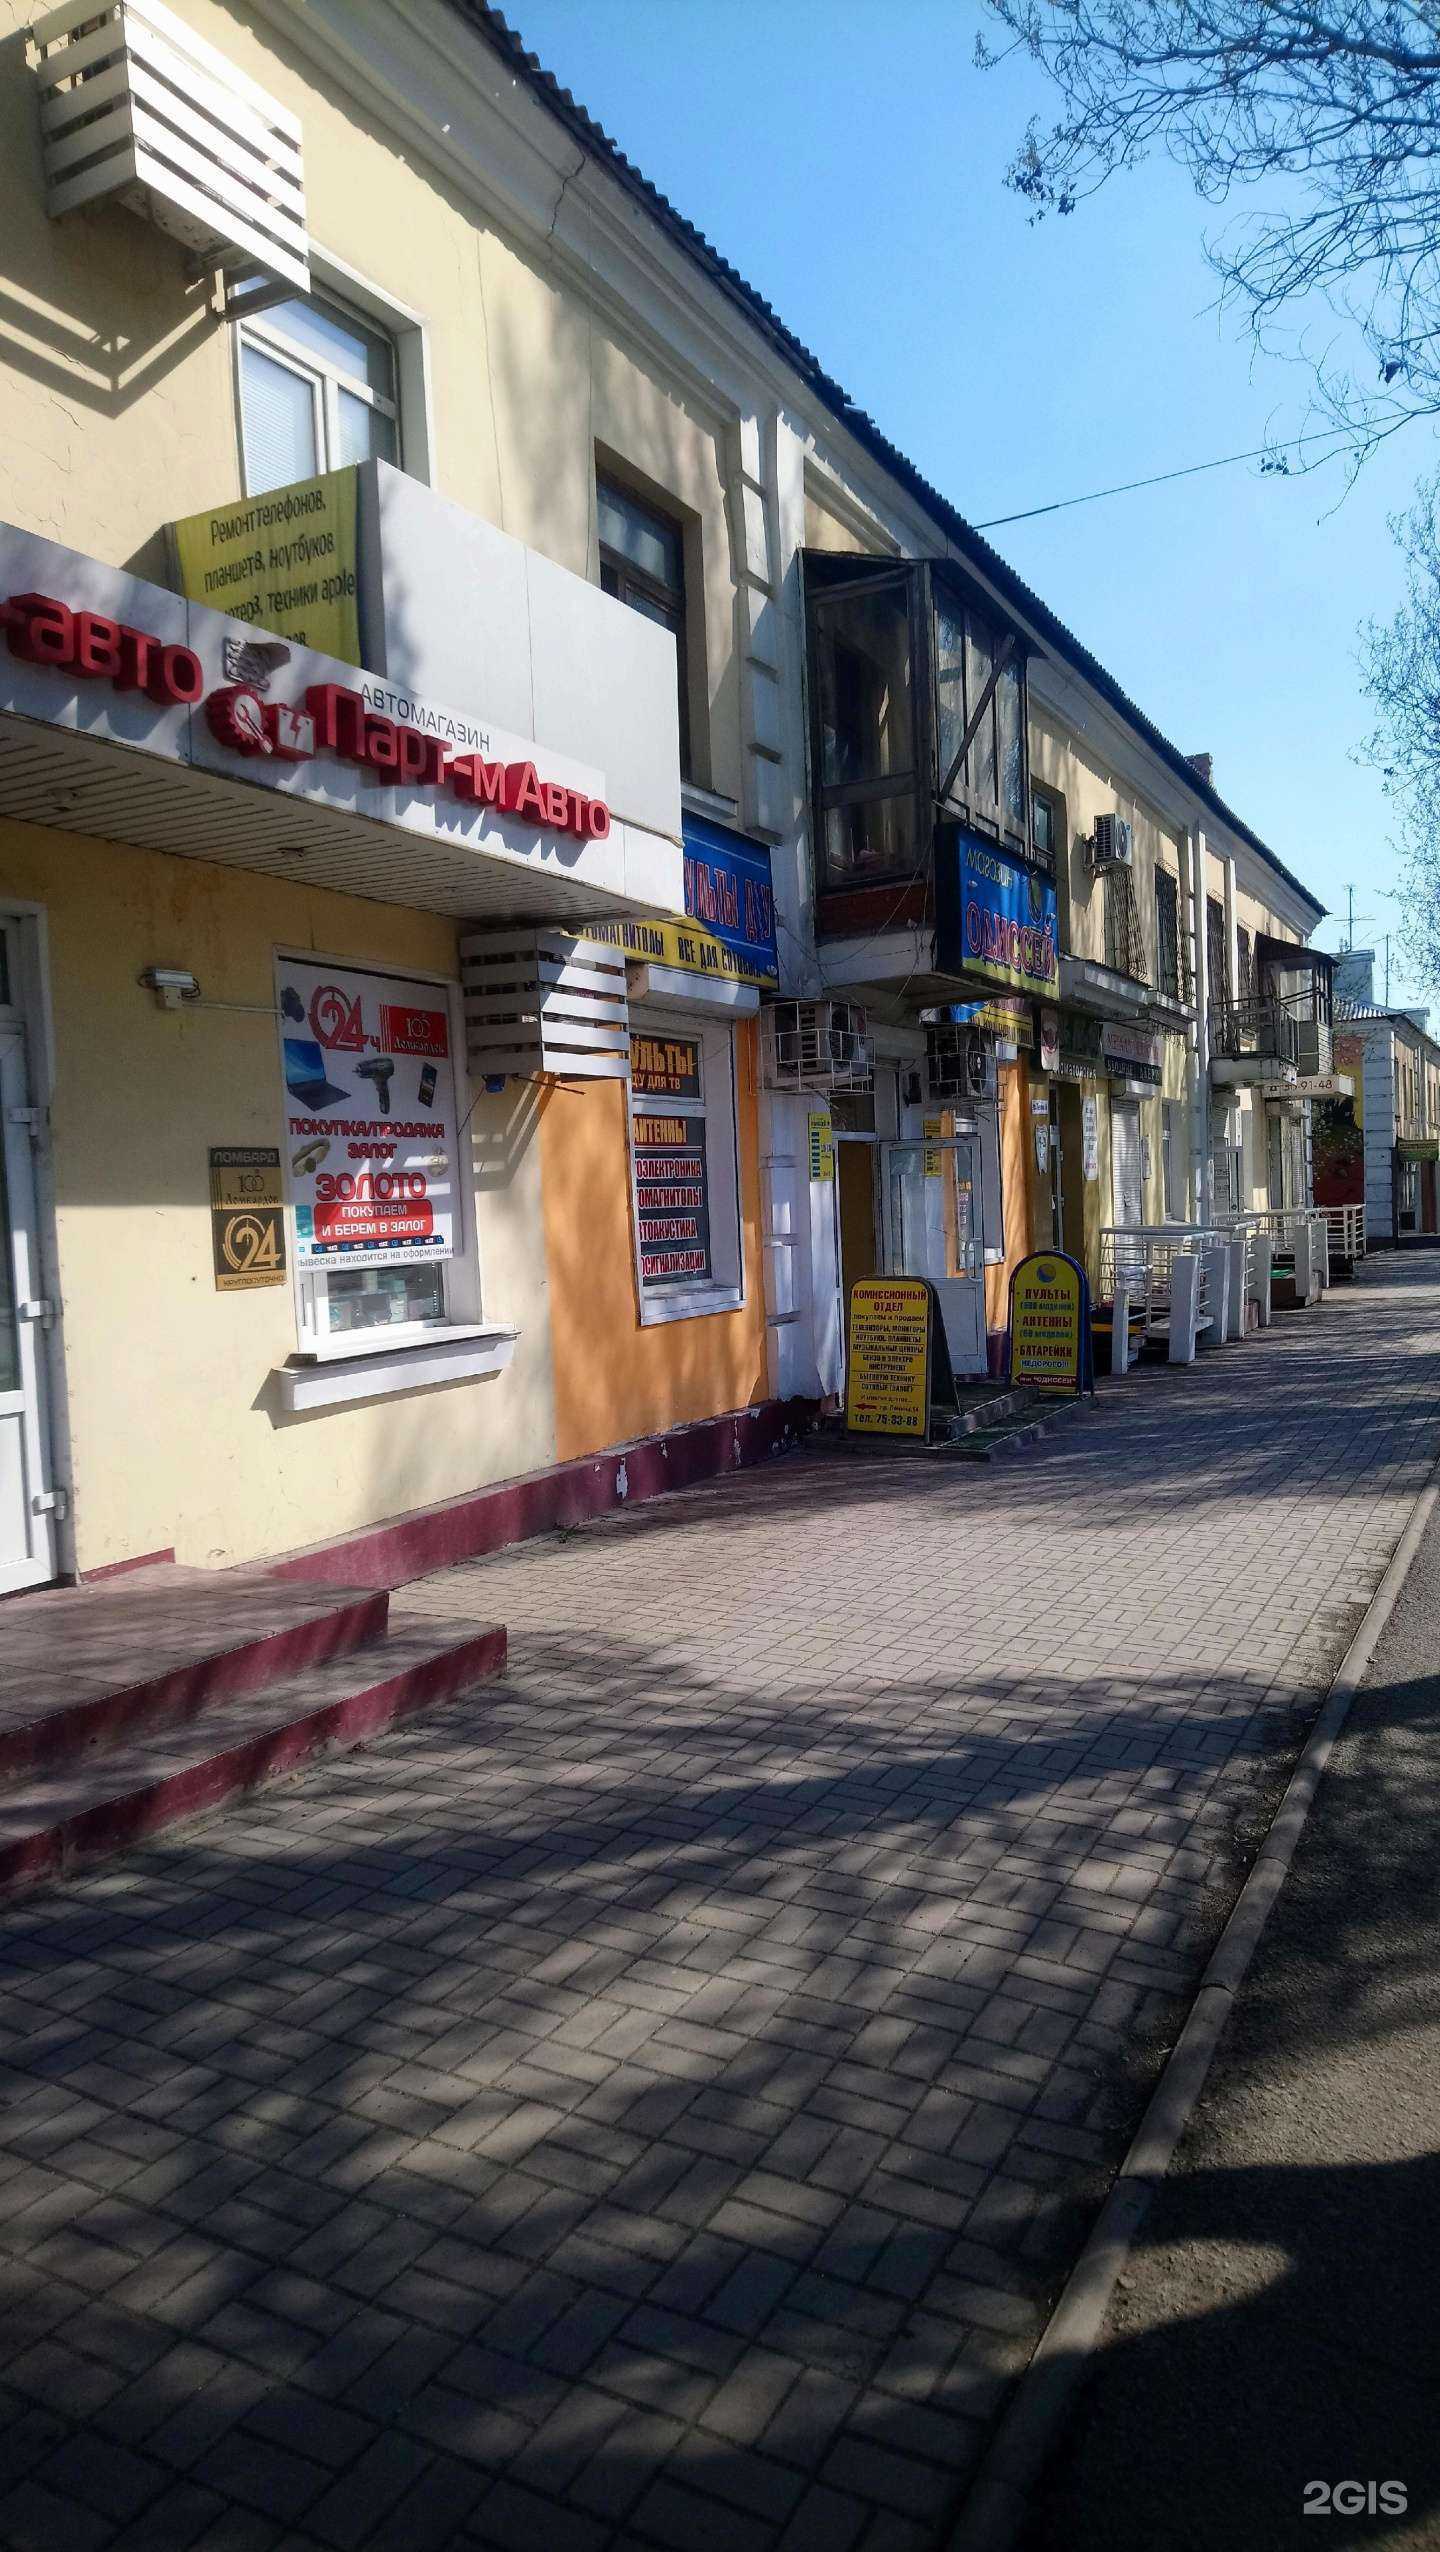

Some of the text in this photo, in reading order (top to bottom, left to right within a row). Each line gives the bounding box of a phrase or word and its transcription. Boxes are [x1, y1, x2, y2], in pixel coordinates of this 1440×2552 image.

[211, 490, 327, 546] Ремонт телефонов,
[267, 583, 318, 613] техники
[322, 569, 355, 606] apple
[361, 683, 490, 752] АВТОМАГАЗИН
[684, 857, 772, 941] УЛЬТЫ ДУ
[966, 901, 1056, 982] ОДИССЕЙ
[678, 936, 697, 963] ВСЕ
[700, 943, 718, 969] ДЛЯ
[631, 1039, 694, 1075] УЛЬТЫ
[648, 1074, 667, 1090] ДЛЯ
[670, 1078, 680, 1090] ТВ
[633, 1119, 687, 1143] АНТЕННЫ
[214, 1152, 278, 1164] ЛОМБАРД
[348, 1143, 397, 1159] ЗАЛОГ
[636, 1159, 702, 1179] ОЭЛЕКТРОНИКА
[315, 1172, 427, 1201] ЗОЛОТО
[638, 1186, 702, 1209] ОМАГНИТОЛЫ
[341, 1204, 408, 1218] ПОКУПАЕМ
[322, 1219, 427, 1236] И БЕРЕМ В ЗАЛОГ
[639, 1218, 697, 1242] ТОАКУСТИКА
[339, 1251, 388, 1265] находится
[853, 1288, 927, 1300] КОМИССИОННЫЙ
[1025, 1288, 1070, 1300] ПУЛЬТЫ
[873, 1301, 904, 1312] ОТДЕЛ
[1022, 1315, 1072, 1328] АНТЕННЫ
[1019, 1344, 1072, 1357] БАТАРЕЙКИ
